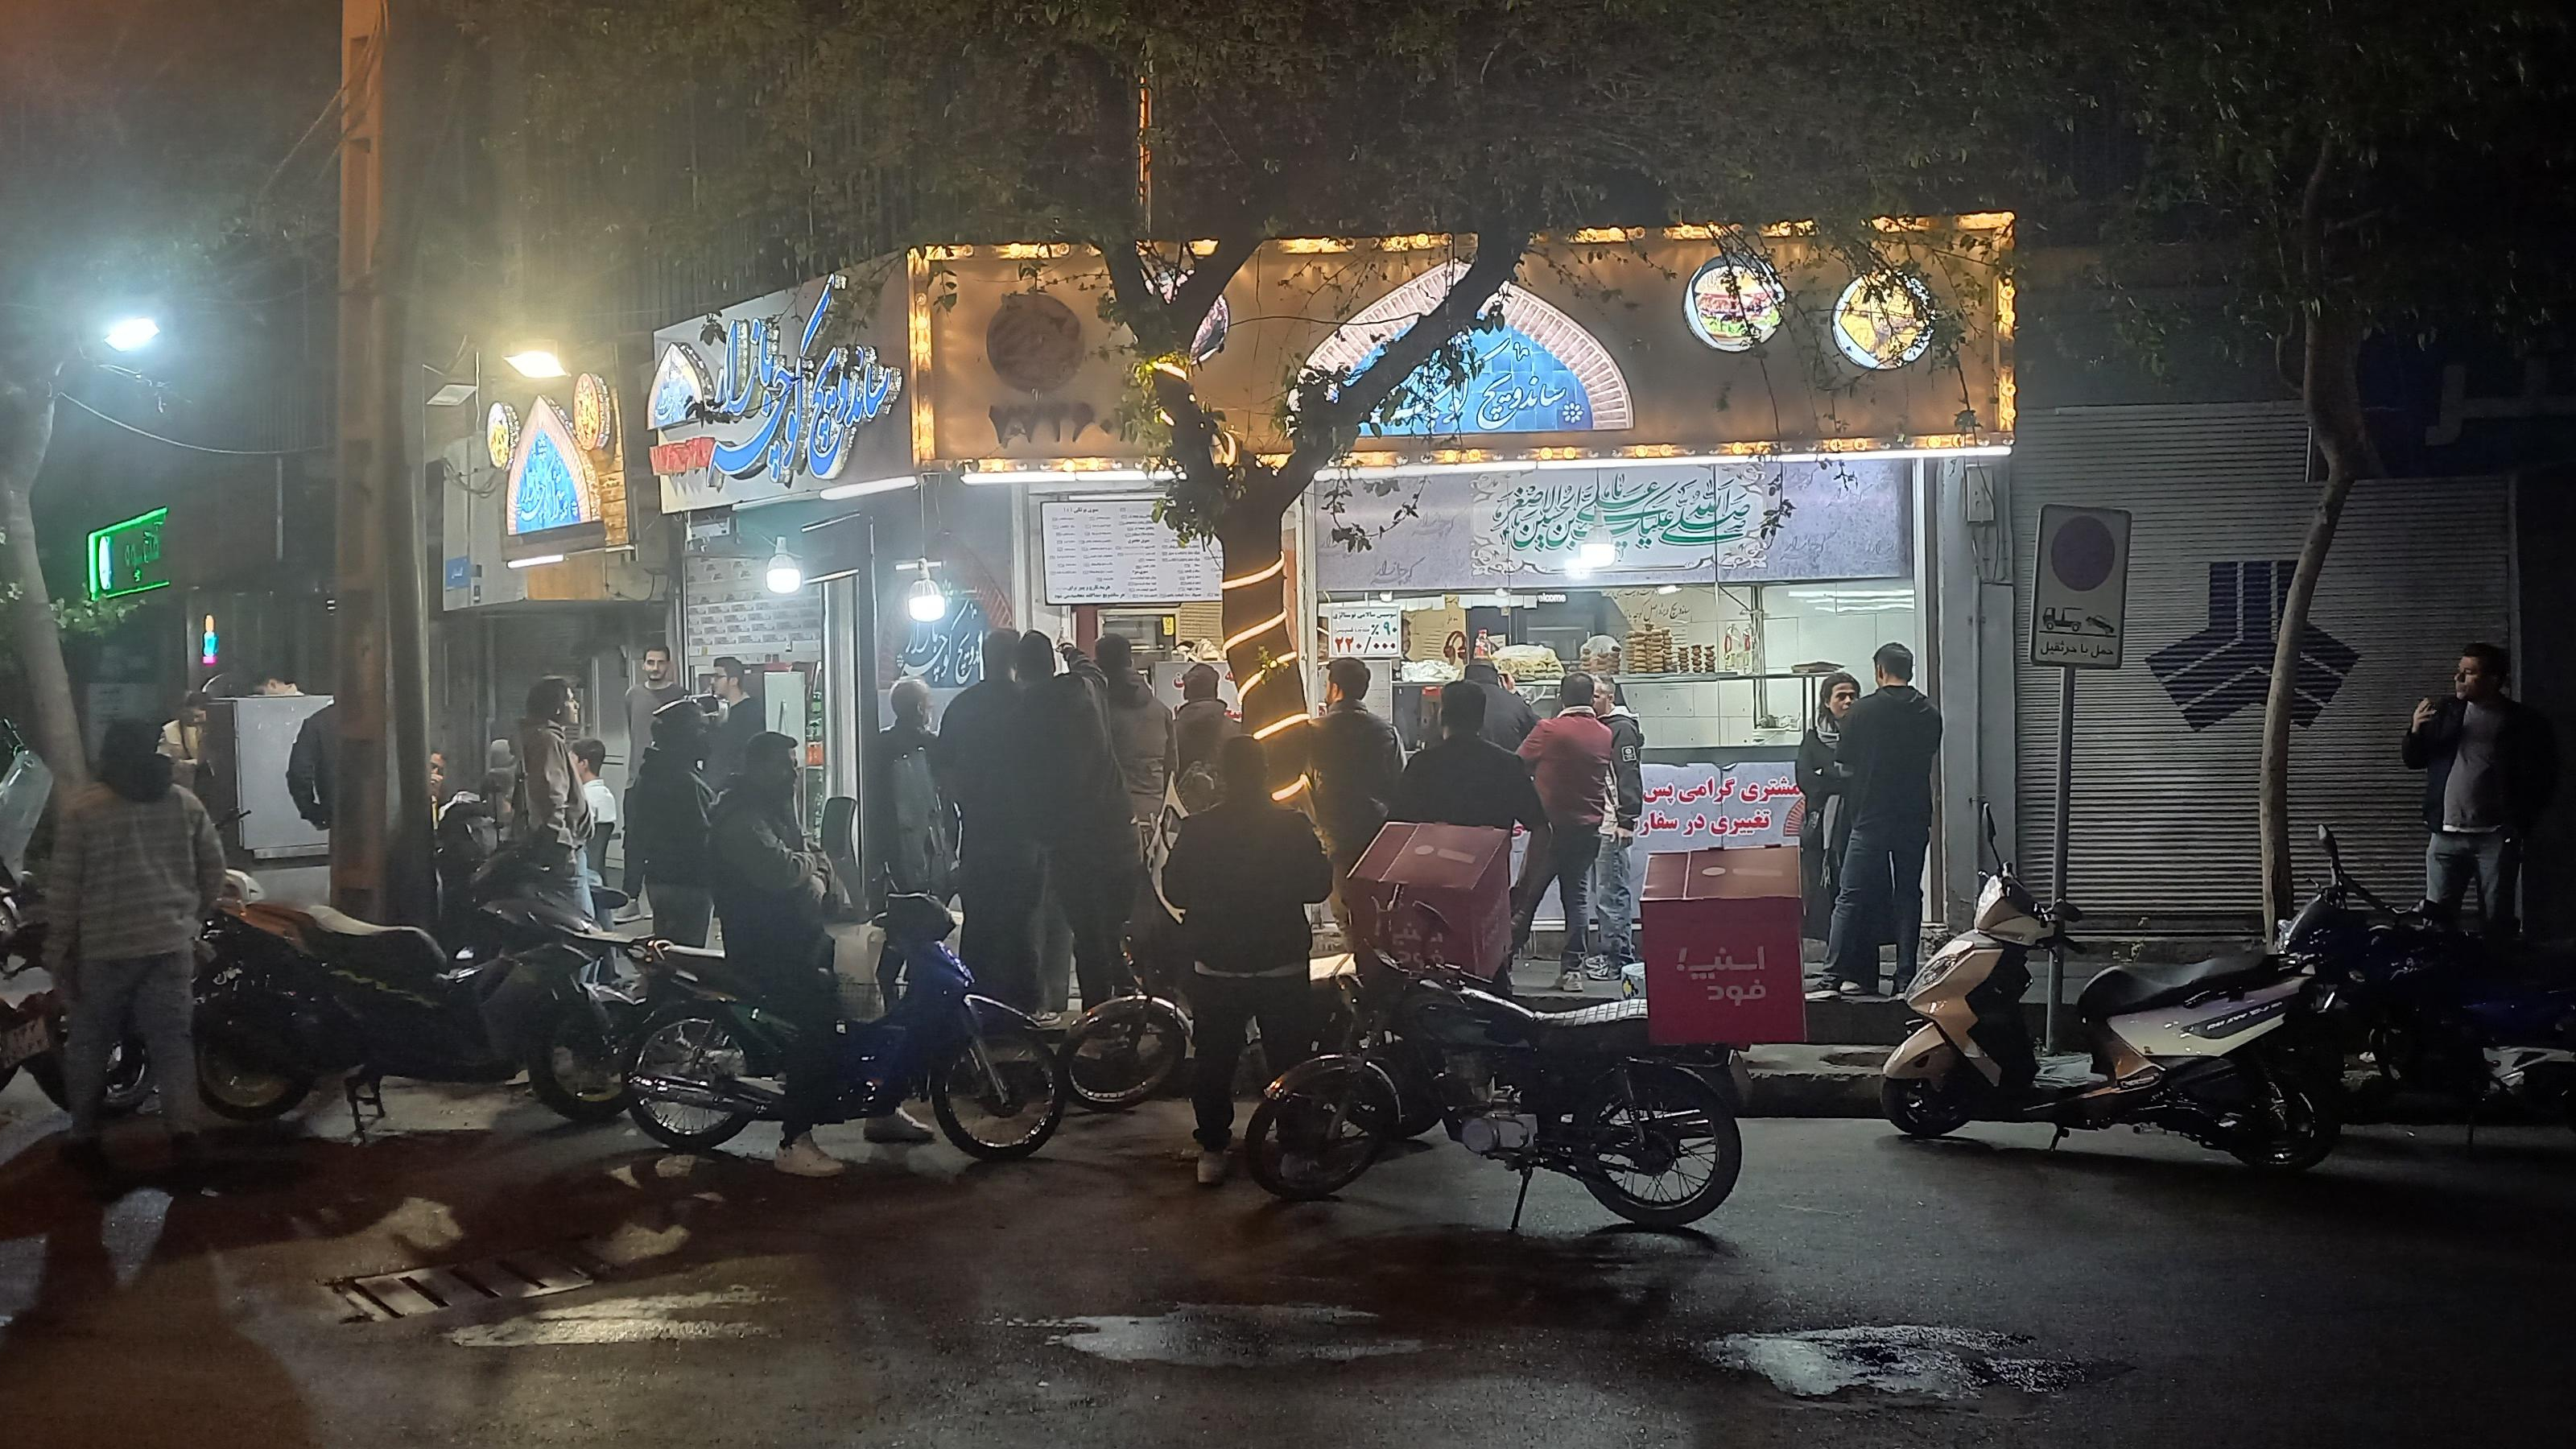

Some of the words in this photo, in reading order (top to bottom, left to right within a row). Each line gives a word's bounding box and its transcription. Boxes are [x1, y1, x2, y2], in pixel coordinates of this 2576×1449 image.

[1477, 374, 1567, 430] ساندویچ
[1537, 593, 1567, 603] elcome
[2091, 644, 2114, 659] حمل
[1643, 783, 1674, 804] پس
[1678, 778, 1736, 803] گرامی
[1682, 813, 1705, 836] در
[1711, 810, 1770, 835] تغییری
[1707, 980, 1767, 1007] فود
